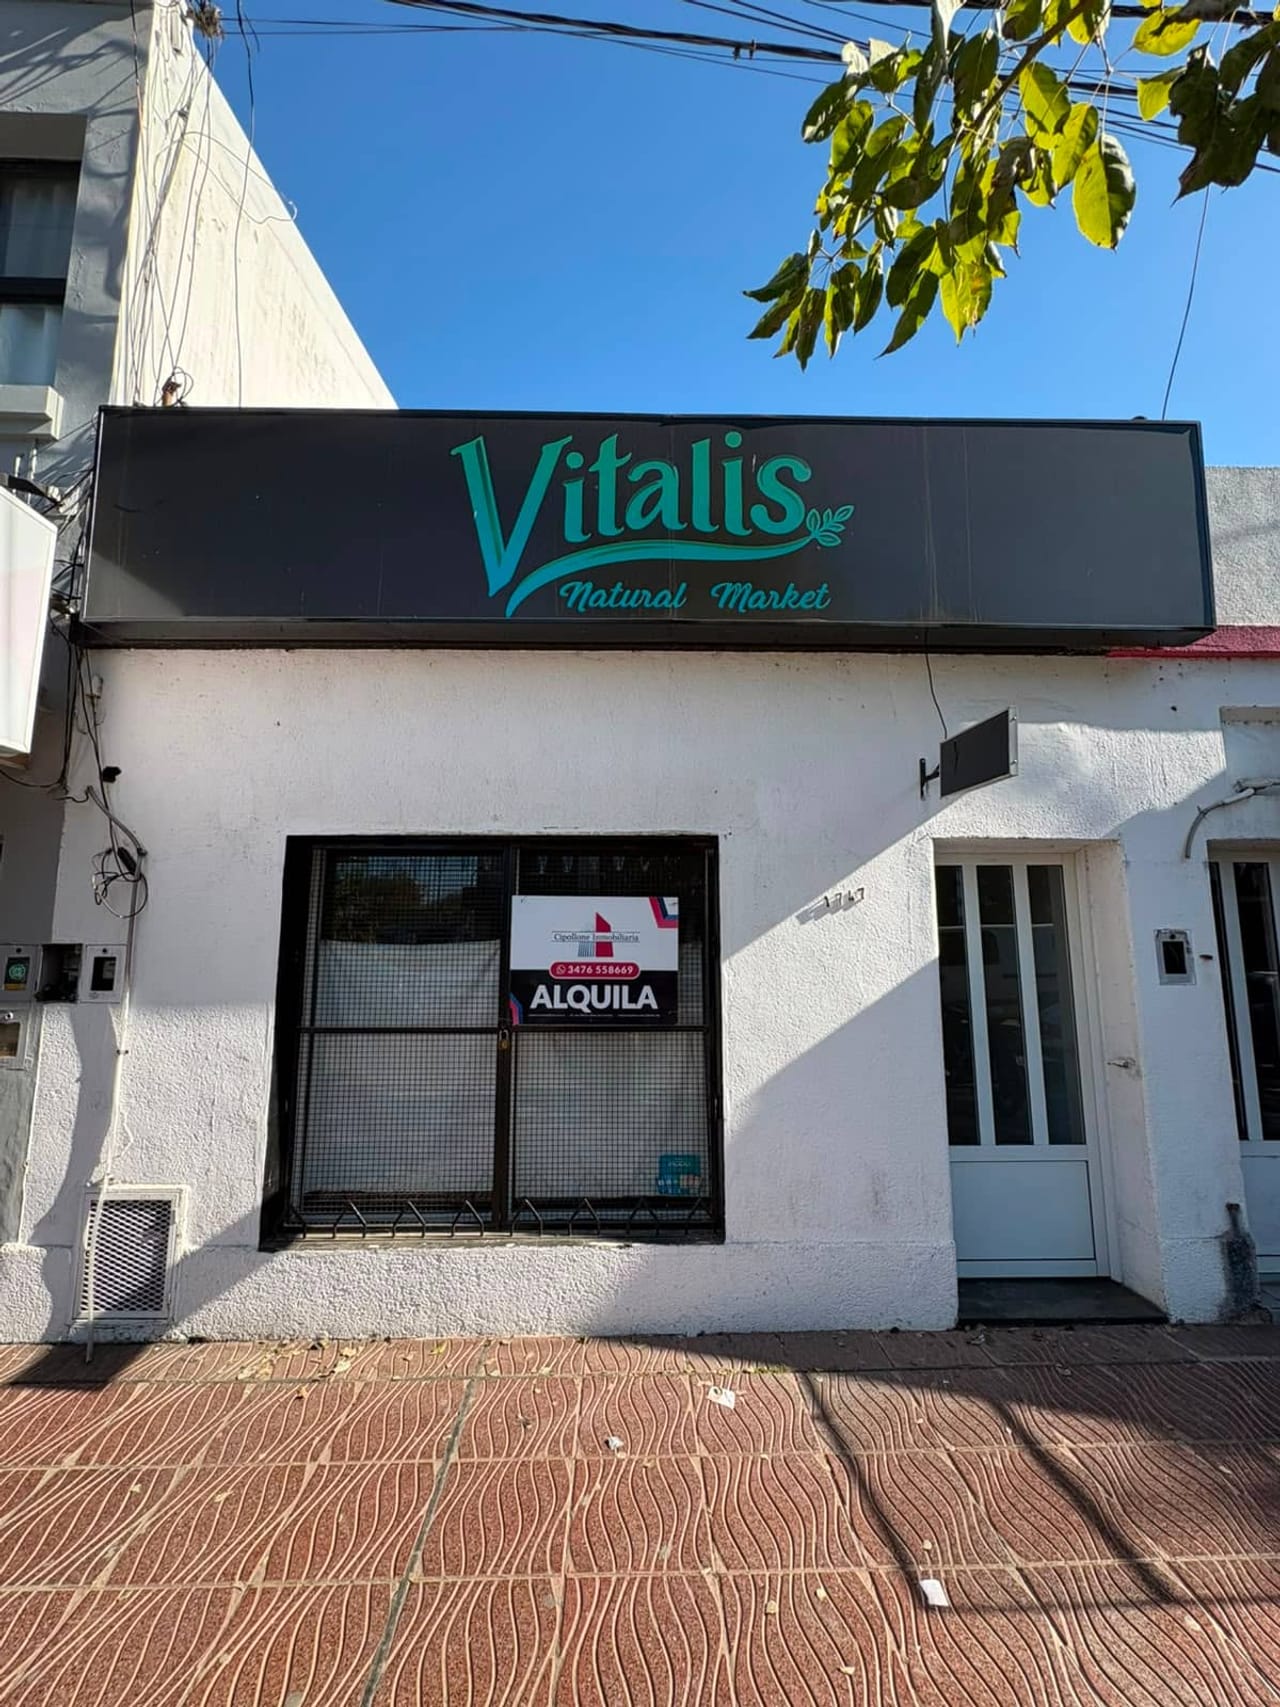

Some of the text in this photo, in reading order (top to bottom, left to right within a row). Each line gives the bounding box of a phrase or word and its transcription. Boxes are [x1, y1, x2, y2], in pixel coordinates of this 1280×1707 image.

[450, 431, 812, 597] Vitalis
[559, 580, 832, 613] Natural Market
[553, 932, 640, 942] Cipollone Inmobiliaria
[567, 965, 634, 975] 3476 558669
[529, 984, 659, 1013] ALQUILA
